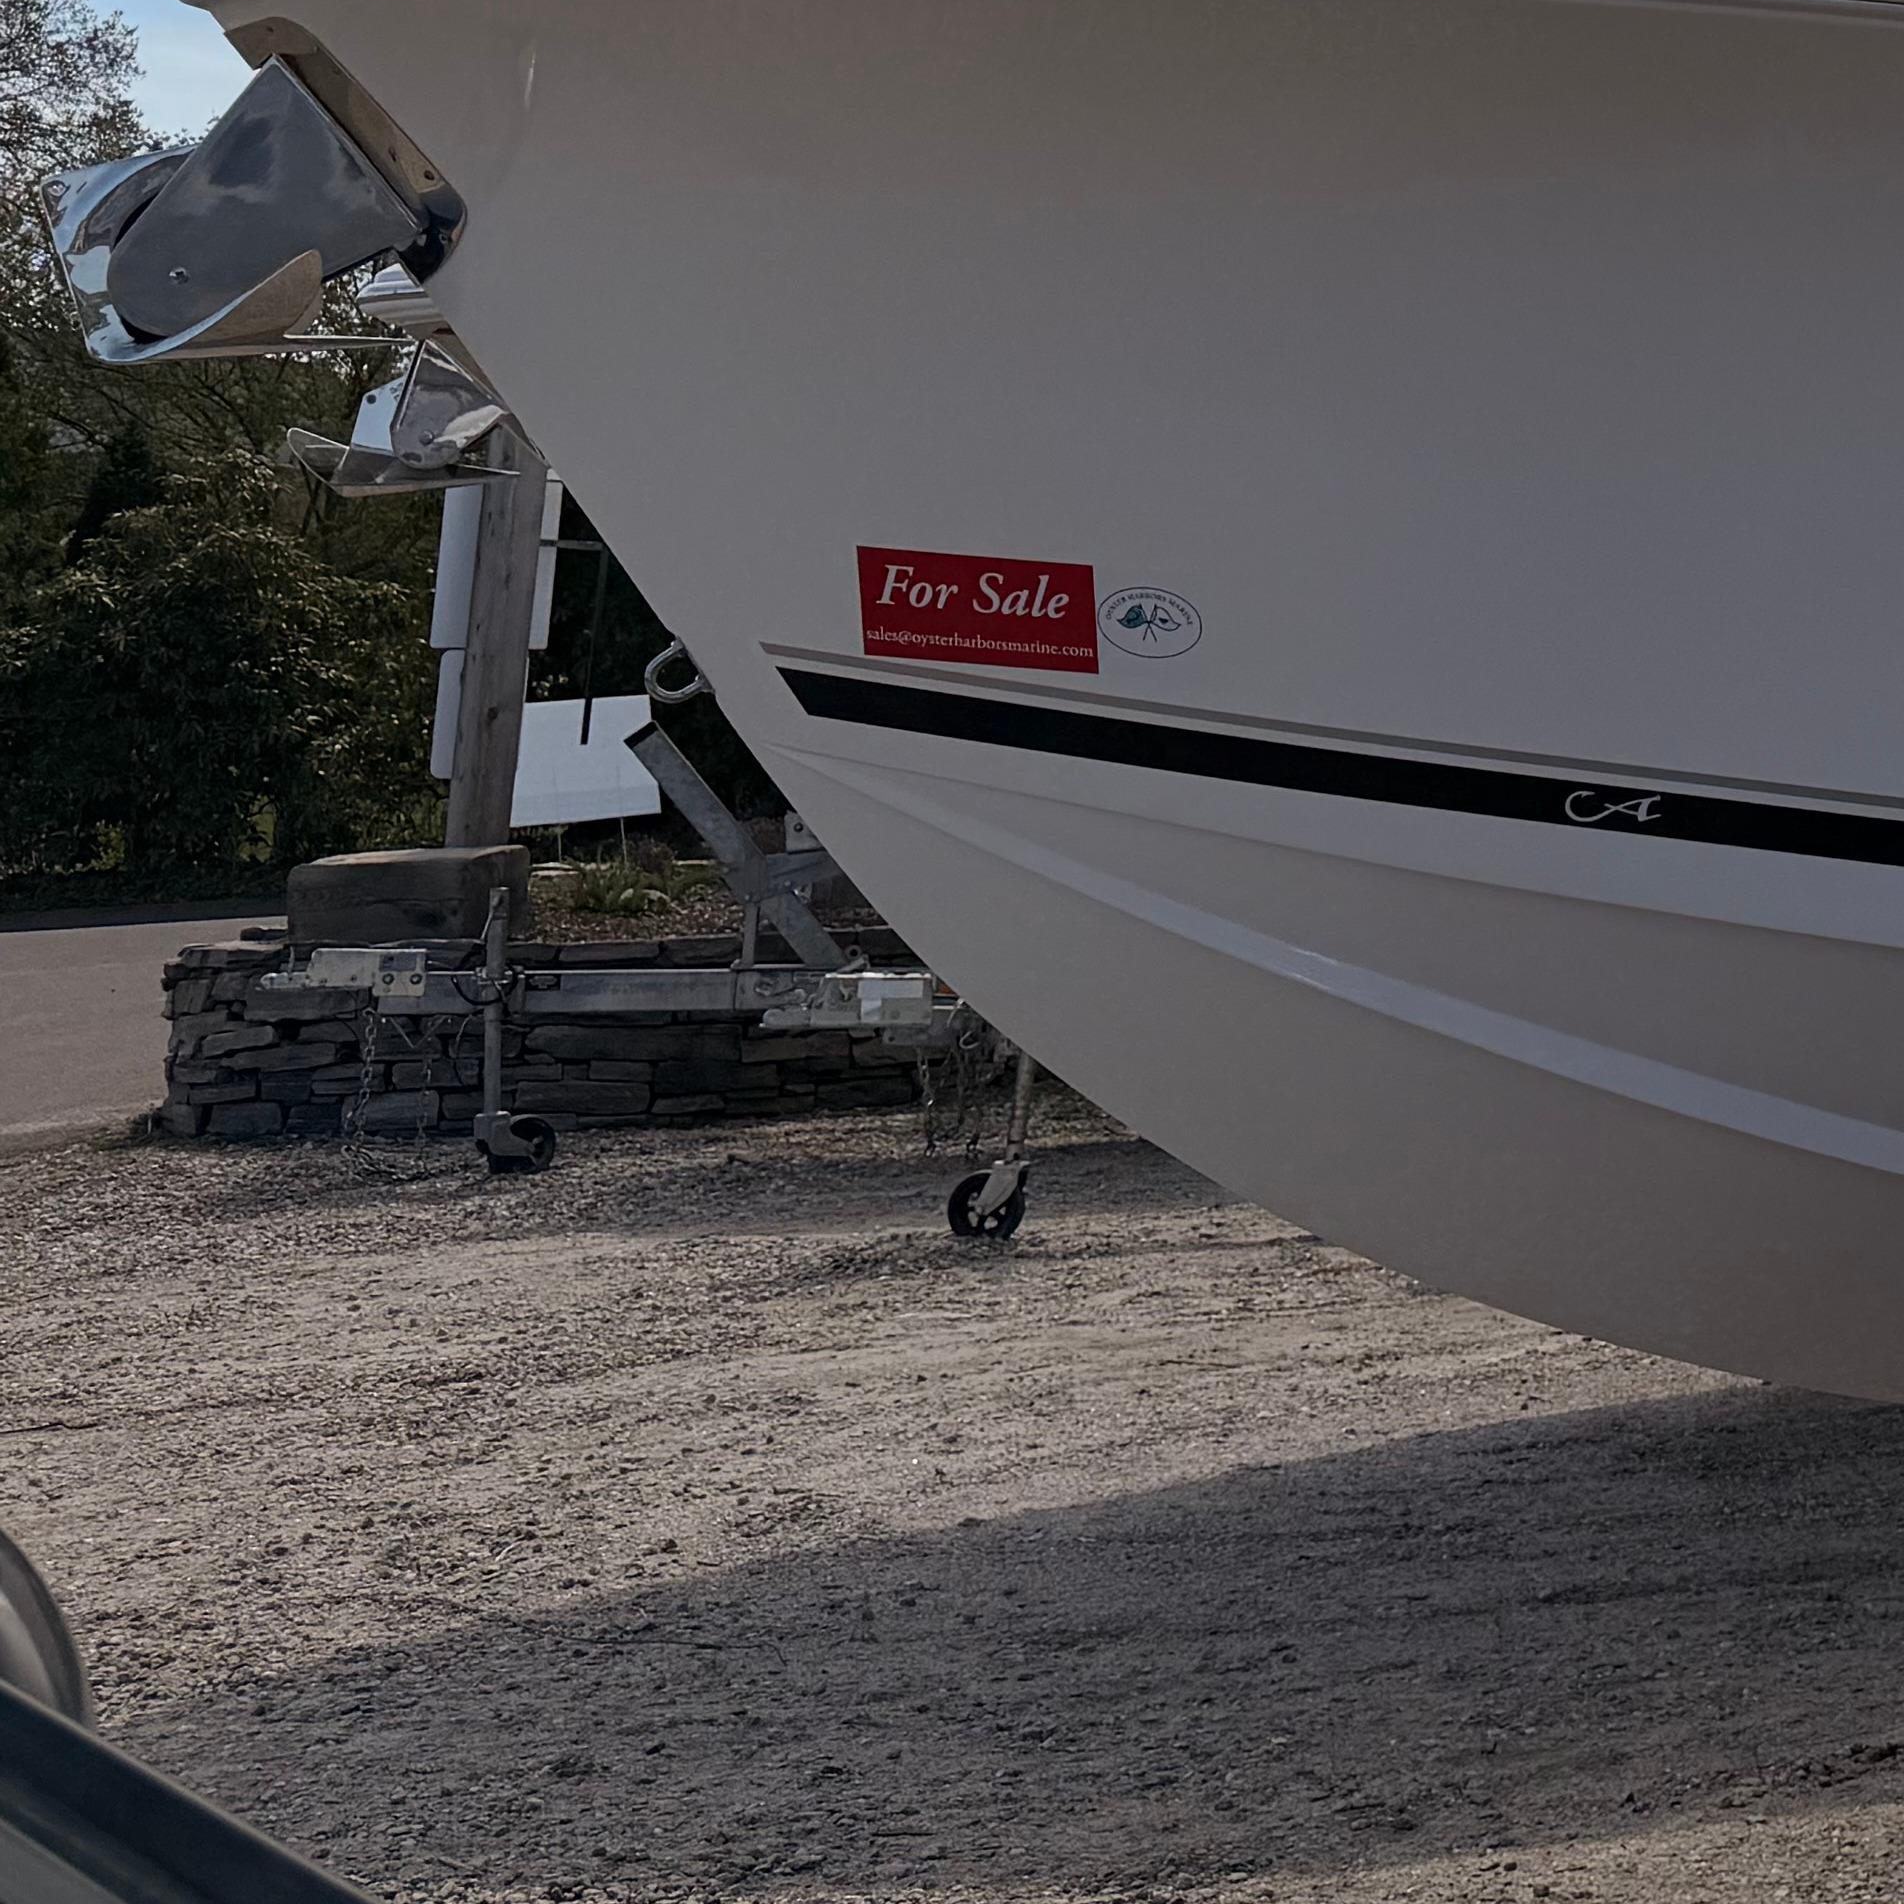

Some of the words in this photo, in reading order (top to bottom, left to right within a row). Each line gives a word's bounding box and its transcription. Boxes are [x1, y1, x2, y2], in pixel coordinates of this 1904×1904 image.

[875, 564, 959, 609] For
[972, 572, 1070, 619] Sale
[866, 626, 1094, 657] sales@oysterharborsmarine.com
